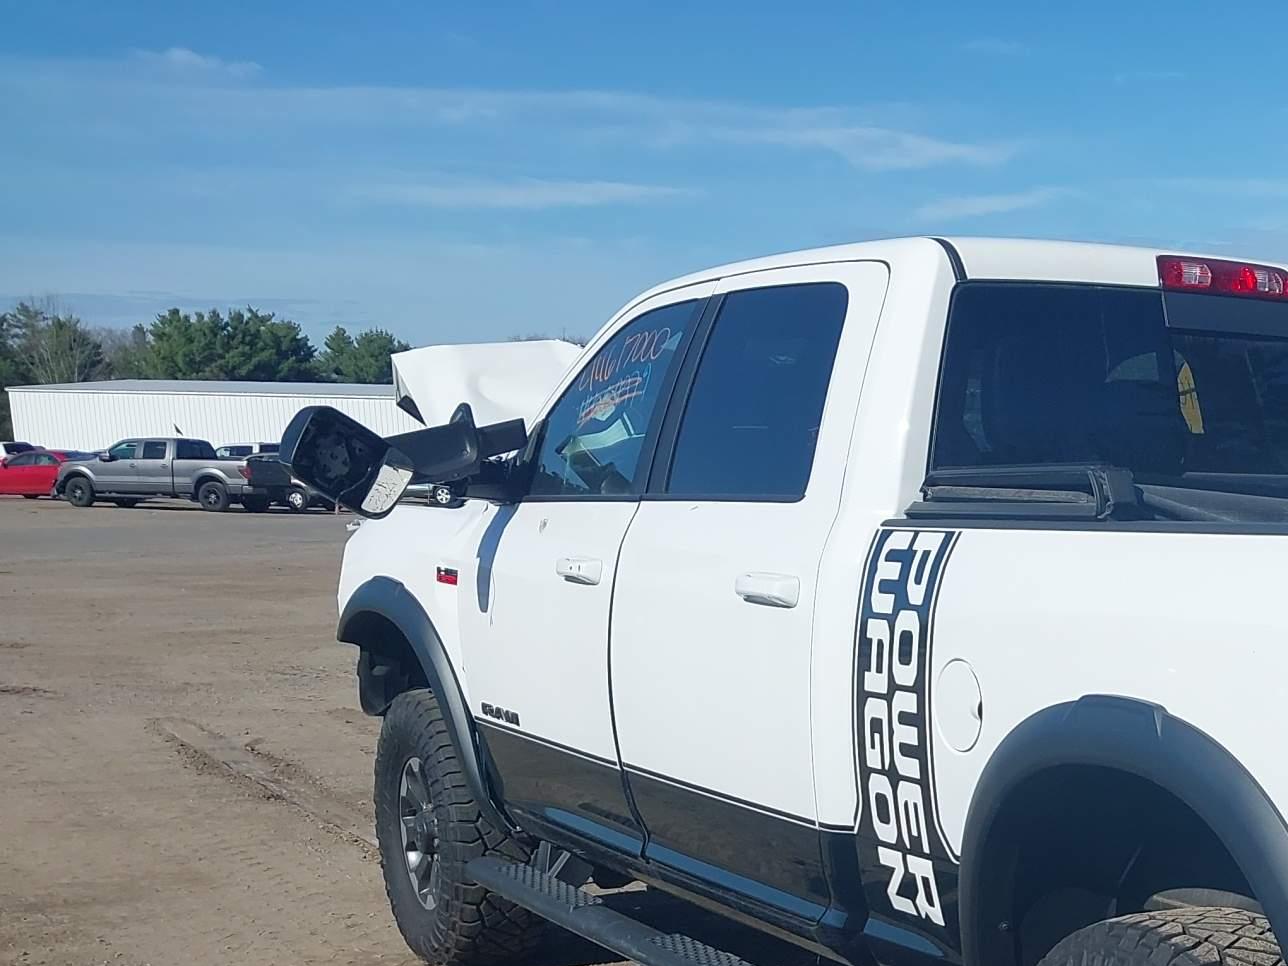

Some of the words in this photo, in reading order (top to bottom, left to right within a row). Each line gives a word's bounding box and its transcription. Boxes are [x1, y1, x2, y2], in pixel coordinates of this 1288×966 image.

[480, 701, 521, 727] RAM
[863, 530, 919, 917] WAGON
[891, 531, 946, 927] POWER
